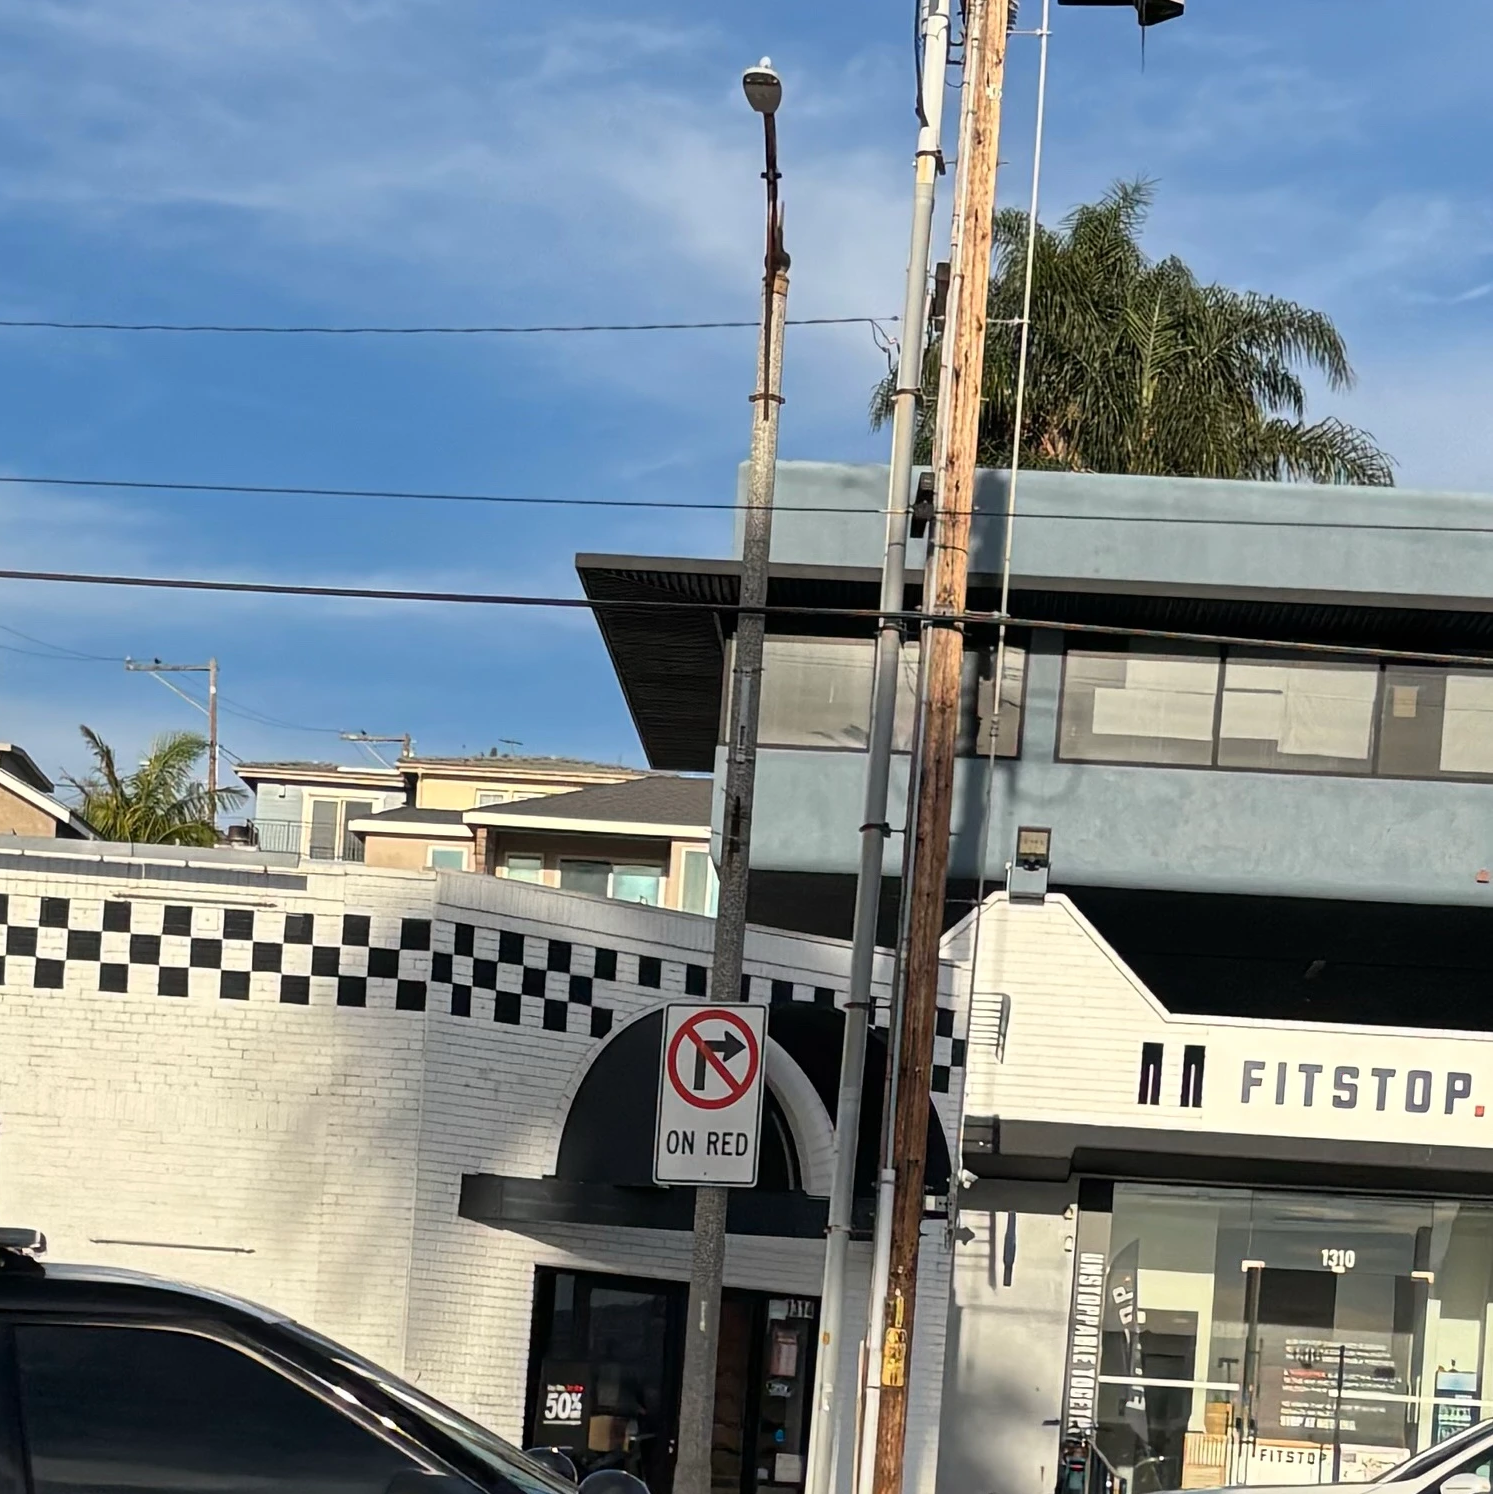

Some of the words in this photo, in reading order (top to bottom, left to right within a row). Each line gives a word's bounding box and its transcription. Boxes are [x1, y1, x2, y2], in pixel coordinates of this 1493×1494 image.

[667, 1130, 695, 1155] ON
[706, 1131, 748, 1156] RED
[1321, 1249, 1356, 1268] 1310
[1072, 1253, 1104, 1364] UNSTOPPABLE
